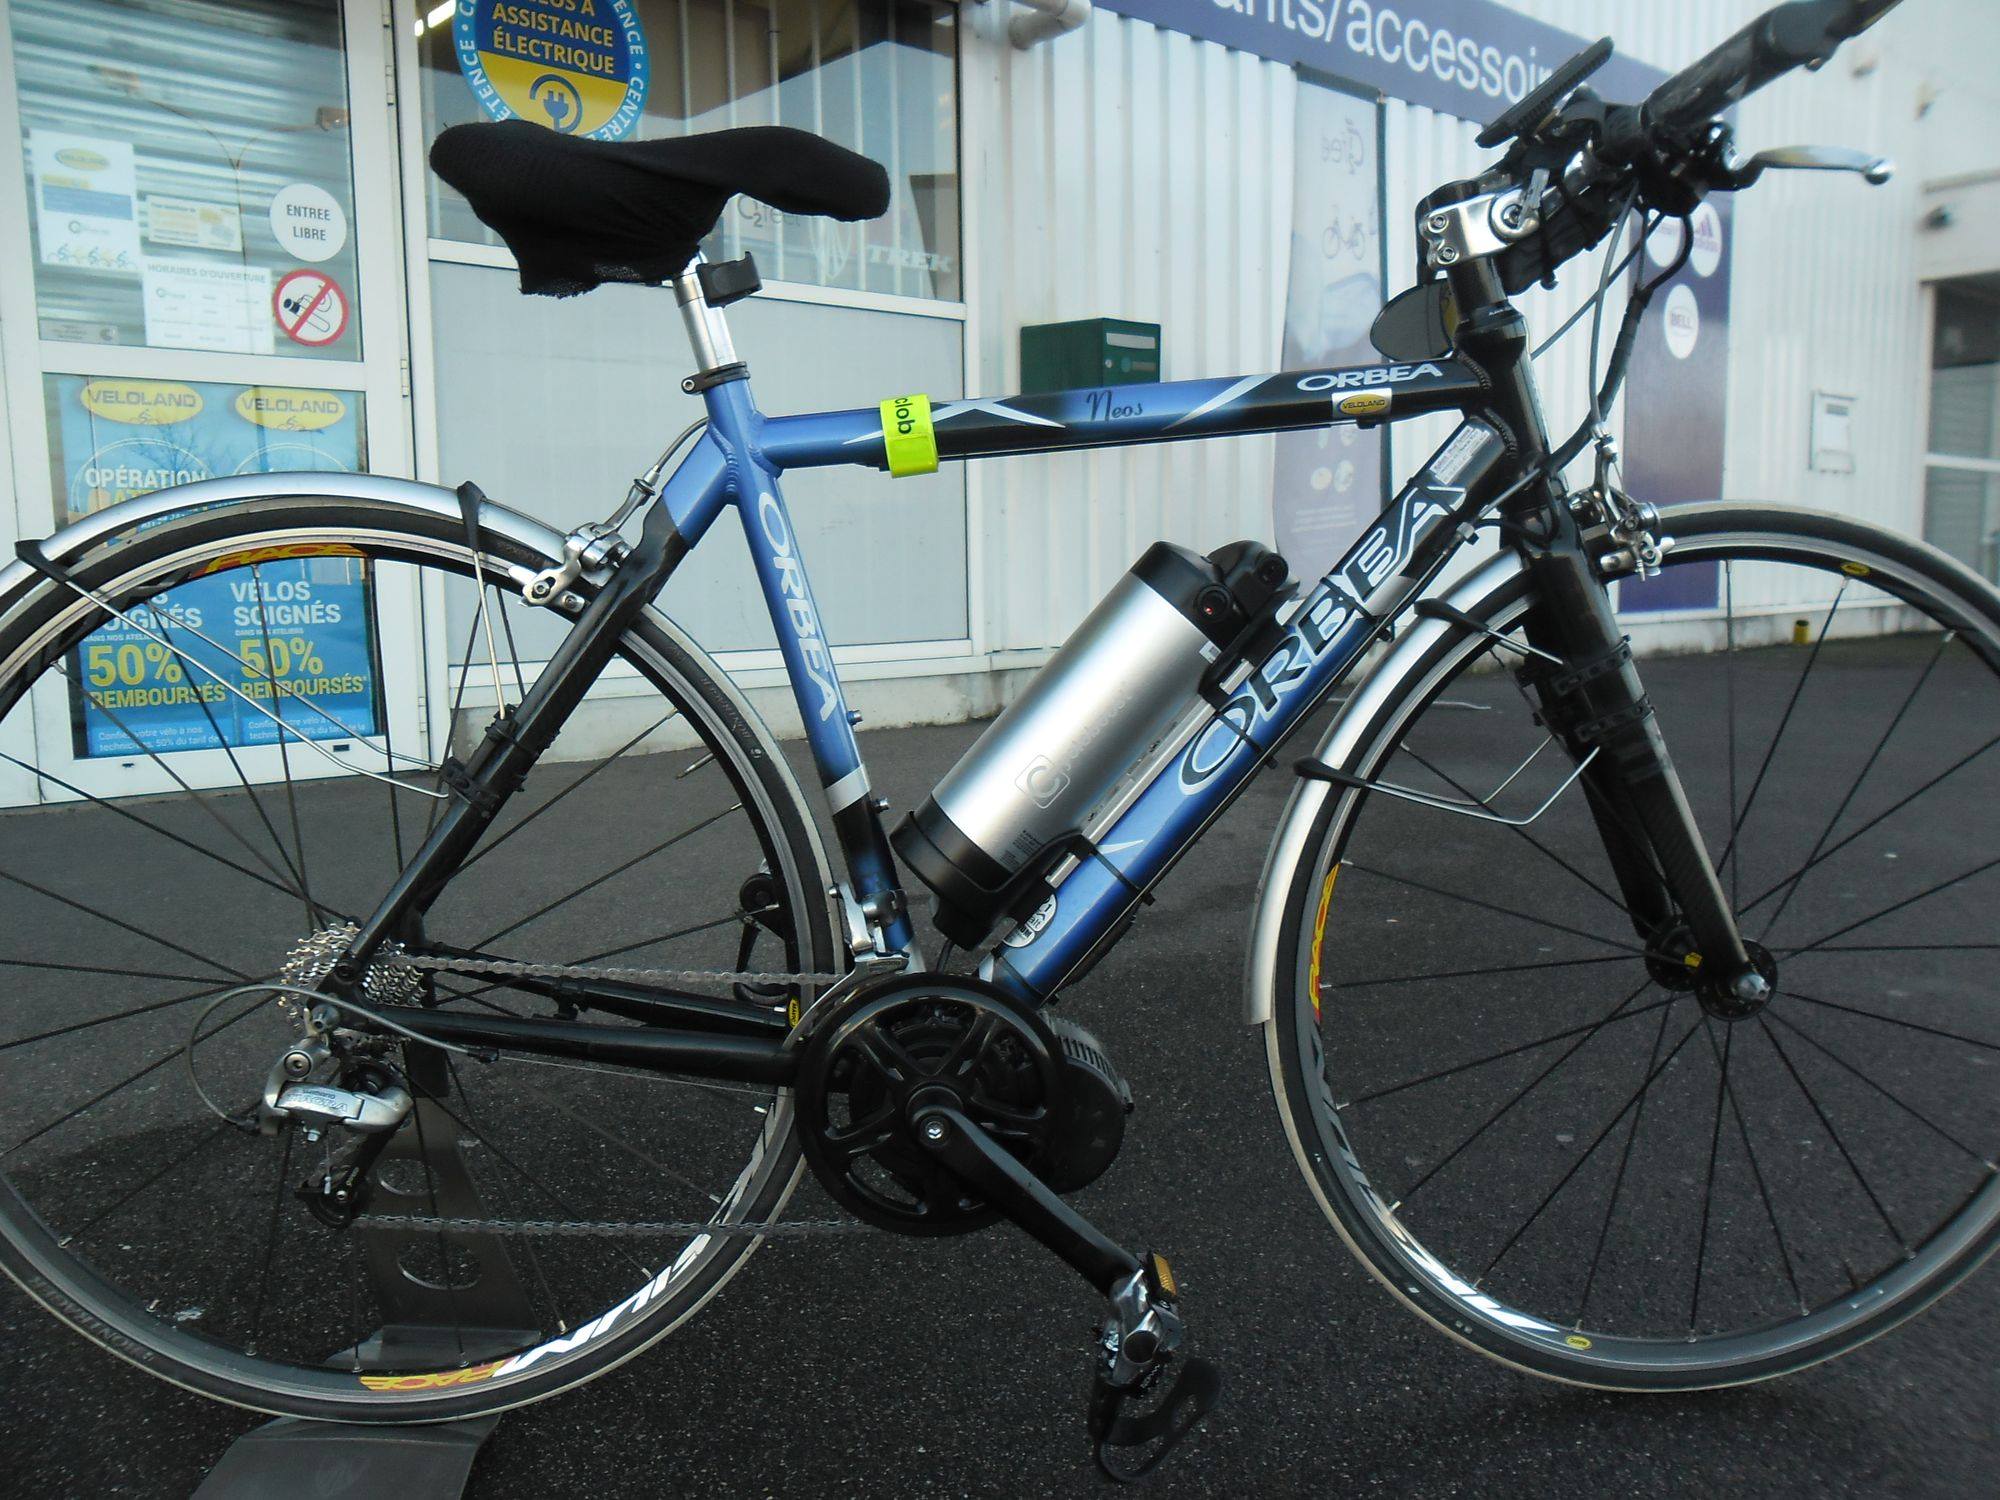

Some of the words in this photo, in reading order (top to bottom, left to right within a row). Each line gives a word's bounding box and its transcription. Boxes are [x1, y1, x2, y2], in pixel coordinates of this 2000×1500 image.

[492, 4, 613, 48] ASSISTANCE
[493, 26, 615, 74] ÉLECTRIQUE
[286, 203, 331, 221] ENTREE
[292, 226, 327, 242] LIBRE
[1296, 363, 1443, 391] ORBEA
[88, 390, 197, 408] VELOLAND
[242, 397, 340, 414] VELOLAND
[1085, 389, 1143, 422] Neos
[1342, 399, 1386, 410] VELOLAND
[894, 397, 916, 435] clob
[84, 464, 207, 489] OPÉRATION
[230, 579, 312, 603] VÉLOS
[103, 603, 203, 631] OIGNÉS
[233, 600, 342, 627] SOIGNÉS
[758, 492, 838, 722] ORBEA
[1177, 486, 1468, 796] ORBEA
[89, 643, 182, 687] 50%
[239, 636, 324, 679] 50%
